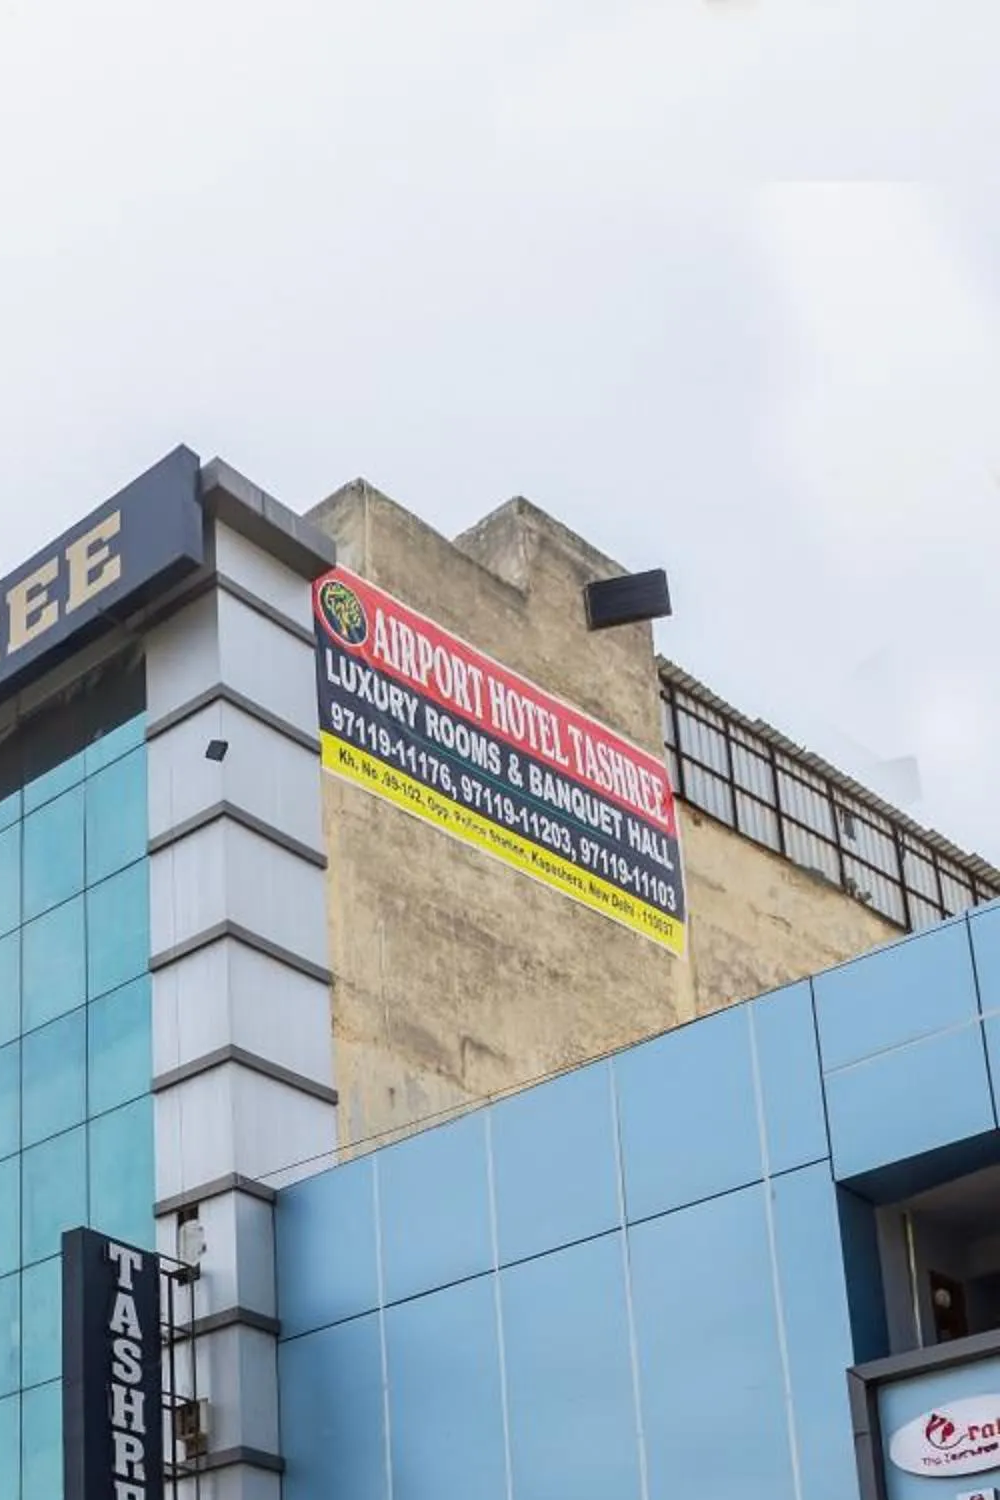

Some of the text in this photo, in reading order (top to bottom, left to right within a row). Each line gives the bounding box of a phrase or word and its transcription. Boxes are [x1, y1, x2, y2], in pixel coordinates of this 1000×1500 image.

[325, 648, 674, 872] LUXURY ROOMS & BANQUET HALL
[331, 701, 677, 912] 97119-11176, 97119-11203, 97119-11103
[373, 607, 668, 826] AIRPORT HOTEL TASHREE
